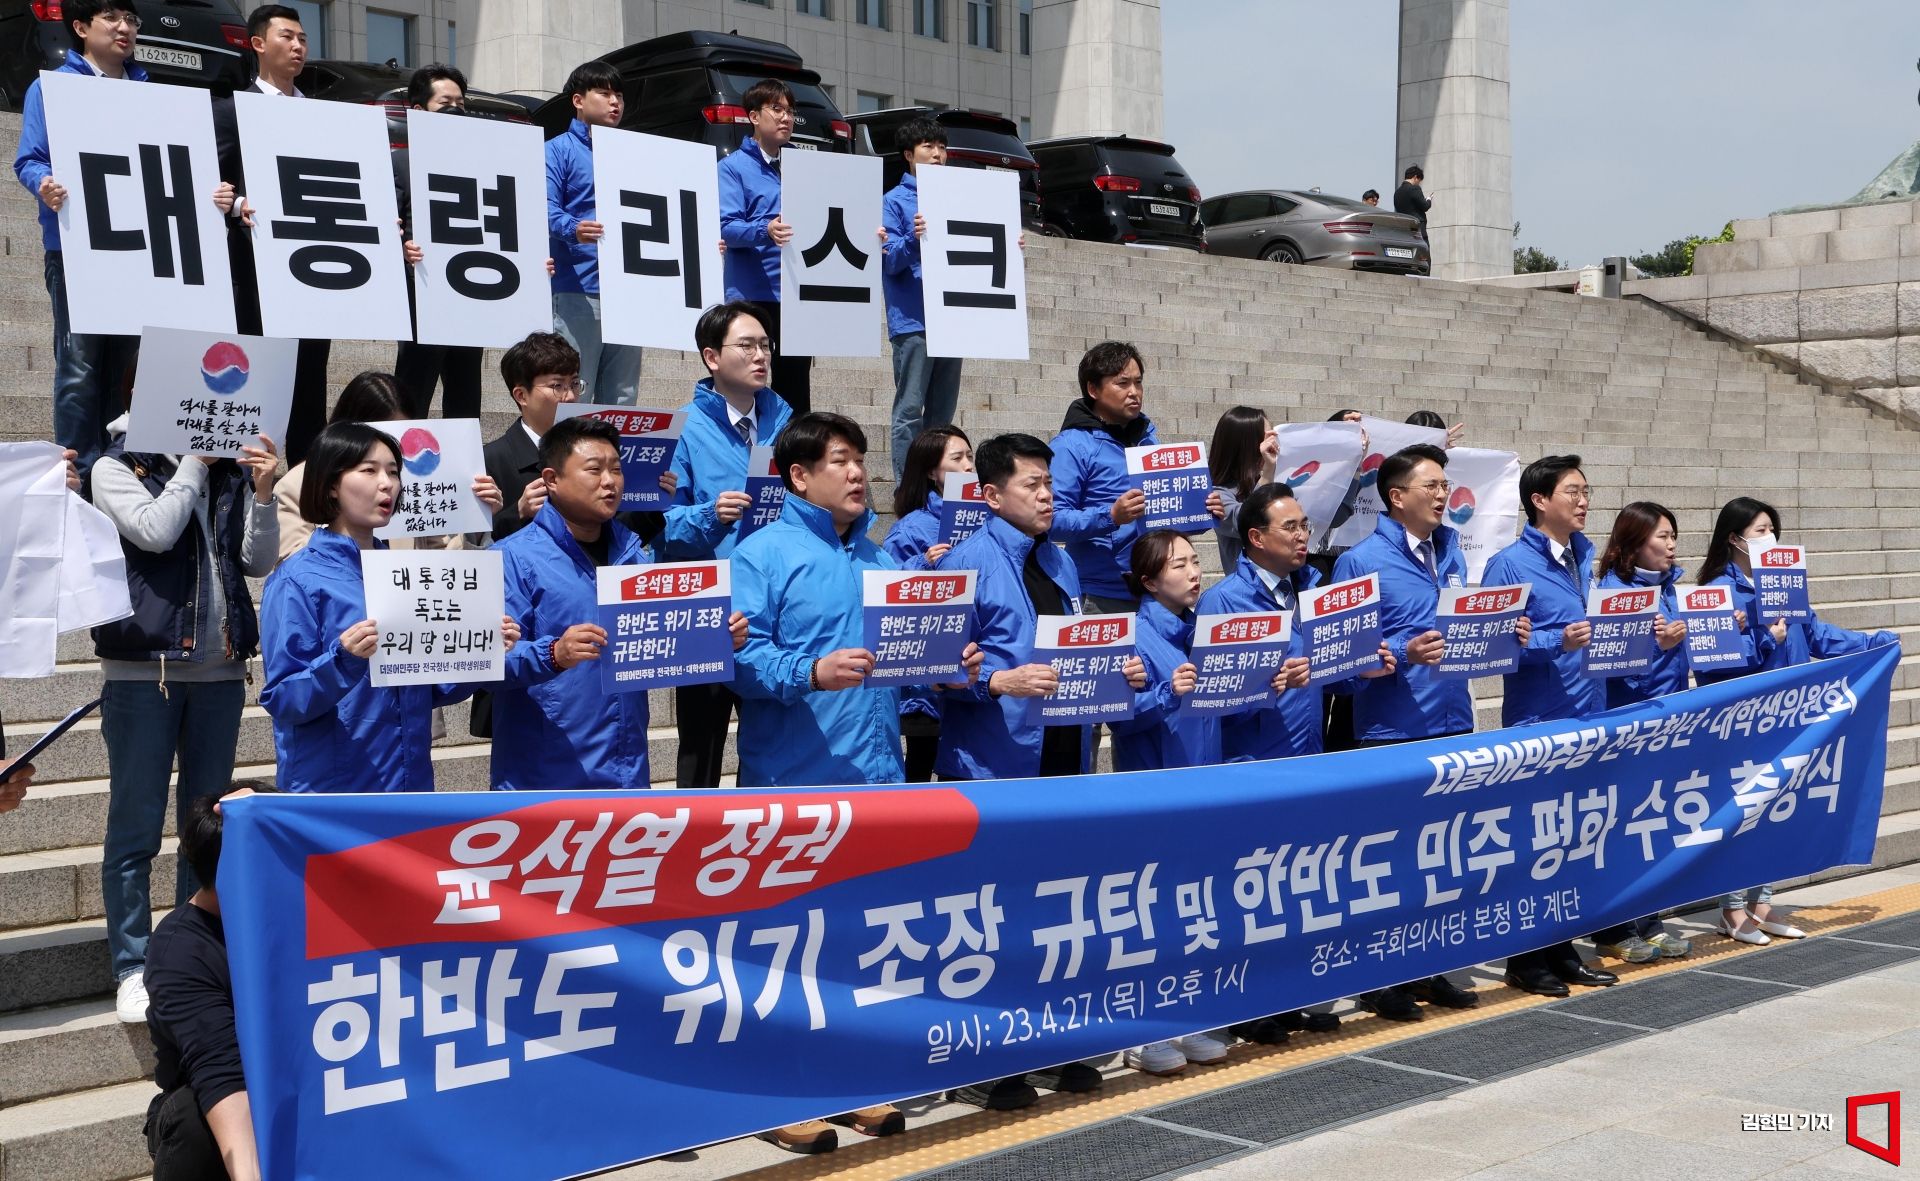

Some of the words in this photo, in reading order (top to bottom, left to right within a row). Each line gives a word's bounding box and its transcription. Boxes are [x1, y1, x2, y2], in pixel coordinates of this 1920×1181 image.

[163, 17, 179, 26] KIA
[79, 143, 205, 286] 대
[272, 155, 380, 290] 통
[427, 173, 521, 300] 령
[619, 189, 703, 309] 리
[799, 206, 871, 303] 스
[943, 219, 1016, 310] 크
[180, 398, 218, 416] 역사를
[221, 401, 260, 416] 팔아서
[177, 417, 214, 434] 미래를
[218, 419, 233, 435] 살
[236, 421, 260, 435] 수는
[629, 415, 656, 432] 정권
[190, 435, 243, 451] 없습니다
[620, 445, 636, 463] 기
[636, 446, 666, 463] 조장
[1151, 451, 1175, 467] 윤석열
[1176, 450, 1193, 465] 정권
[401, 482, 421, 497] 사를
[424, 481, 457, 496] 팔아서
[760, 486, 786, 504] 한반
[1142, 478, 1170, 496] 한반도
[1172, 475, 1190, 492] 위기
[1192, 474, 1208, 489] 조장
[400, 499, 421, 514] 래를
[424, 499, 436, 513] 살
[439, 499, 458, 512] 수는
[405, 517, 447, 532] 없습니다
[634, 573, 674, 595] 윤석열
[678, 572, 703, 592] 정권
[898, 580, 933, 600] 윤석열
[935, 580, 956, 599] 정권
[1322, 590, 1347, 611] 윤석열
[1350, 585, 1365, 603] 정권
[1466, 594, 1495, 610] 윤석열
[1496, 592, 1513, 609] 정권
[1609, 596, 1632, 611] 윤석열
[1634, 594, 1648, 609] 정권
[414, 598, 461, 622] 독도는
[617, 612, 659, 636] 한반도
[664, 609, 692, 632] 위기
[695, 607, 723, 628] 조장
[880, 615, 917, 637] 한반도
[919, 614, 943, 635] 위기
[943, 613, 966, 634] 조장
[1219, 621, 1248, 640] 윤석열
[1250, 620, 1270, 637] 정권
[1313, 621, 1340, 645] 한반도
[1343, 615, 1360, 636] 위기
[1362, 610, 1378, 629] 조장
[1447, 623, 1480, 639] 한반도
[1482, 620, 1501, 638] 위기
[1593, 623, 1620, 639] 한반도
[1622, 621, 1638, 637] 위기
[1637, 619, 1653, 635] 조장
[381, 631, 413, 655] 우리
[420, 630, 437, 654] 땅
[443, 629, 494, 654] 입니다!
[1069, 623, 1099, 642] 윤석열
[1102, 623, 1119, 640] 정권
[612, 637, 677, 663] 규탄한다!
[875, 640, 926, 662] 규탄한다!
[1310, 640, 1351, 666] 규탄한다!
[1589, 641, 1627, 658] 규탄한다!
[380, 663, 420, 675] 더불어민주당
[1088, 655, 1110, 675] 위기
[1202, 653, 1234, 673] 한반도
[1237, 651, 1259, 670] 위기
[1260, 649, 1282, 668] 조장
[615, 669, 655, 682] 더불어민주당
[1194, 674, 1244, 693] 규탄한다!
[1044, 679, 1096, 700] 탄한다!
[1423, 726, 1608, 797] 더불어민주당
[433, 808, 690, 924] 윤석열
[695, 801, 852, 897] 정권
[307, 944, 619, 1115] 한반도
[662, 908, 826, 1045] 위기
[853, 884, 1005, 1007] 조장
[1032, 863, 1159, 984] 규탄
[1176, 876, 1220, 955] 및
[1233, 830, 1400, 945] 한반도
[1417, 806, 1515, 907] 민주
[1530, 783, 1617, 881] 평화
[1625, 769, 1723, 862] 수호
[1730, 735, 1846, 838] 출정식
[1310, 939, 1360, 977] 장소:
[1366, 910, 1467, 962] 국회의사당
[1473, 899, 1512, 940] 본청
[1518, 896, 1537, 931] 앞
[1543, 887, 1581, 923] 계단
[927, 1014, 991, 1064] 일시:
[1155, 969, 1203, 1009] 오후
[1214, 959, 1249, 994] 1시
